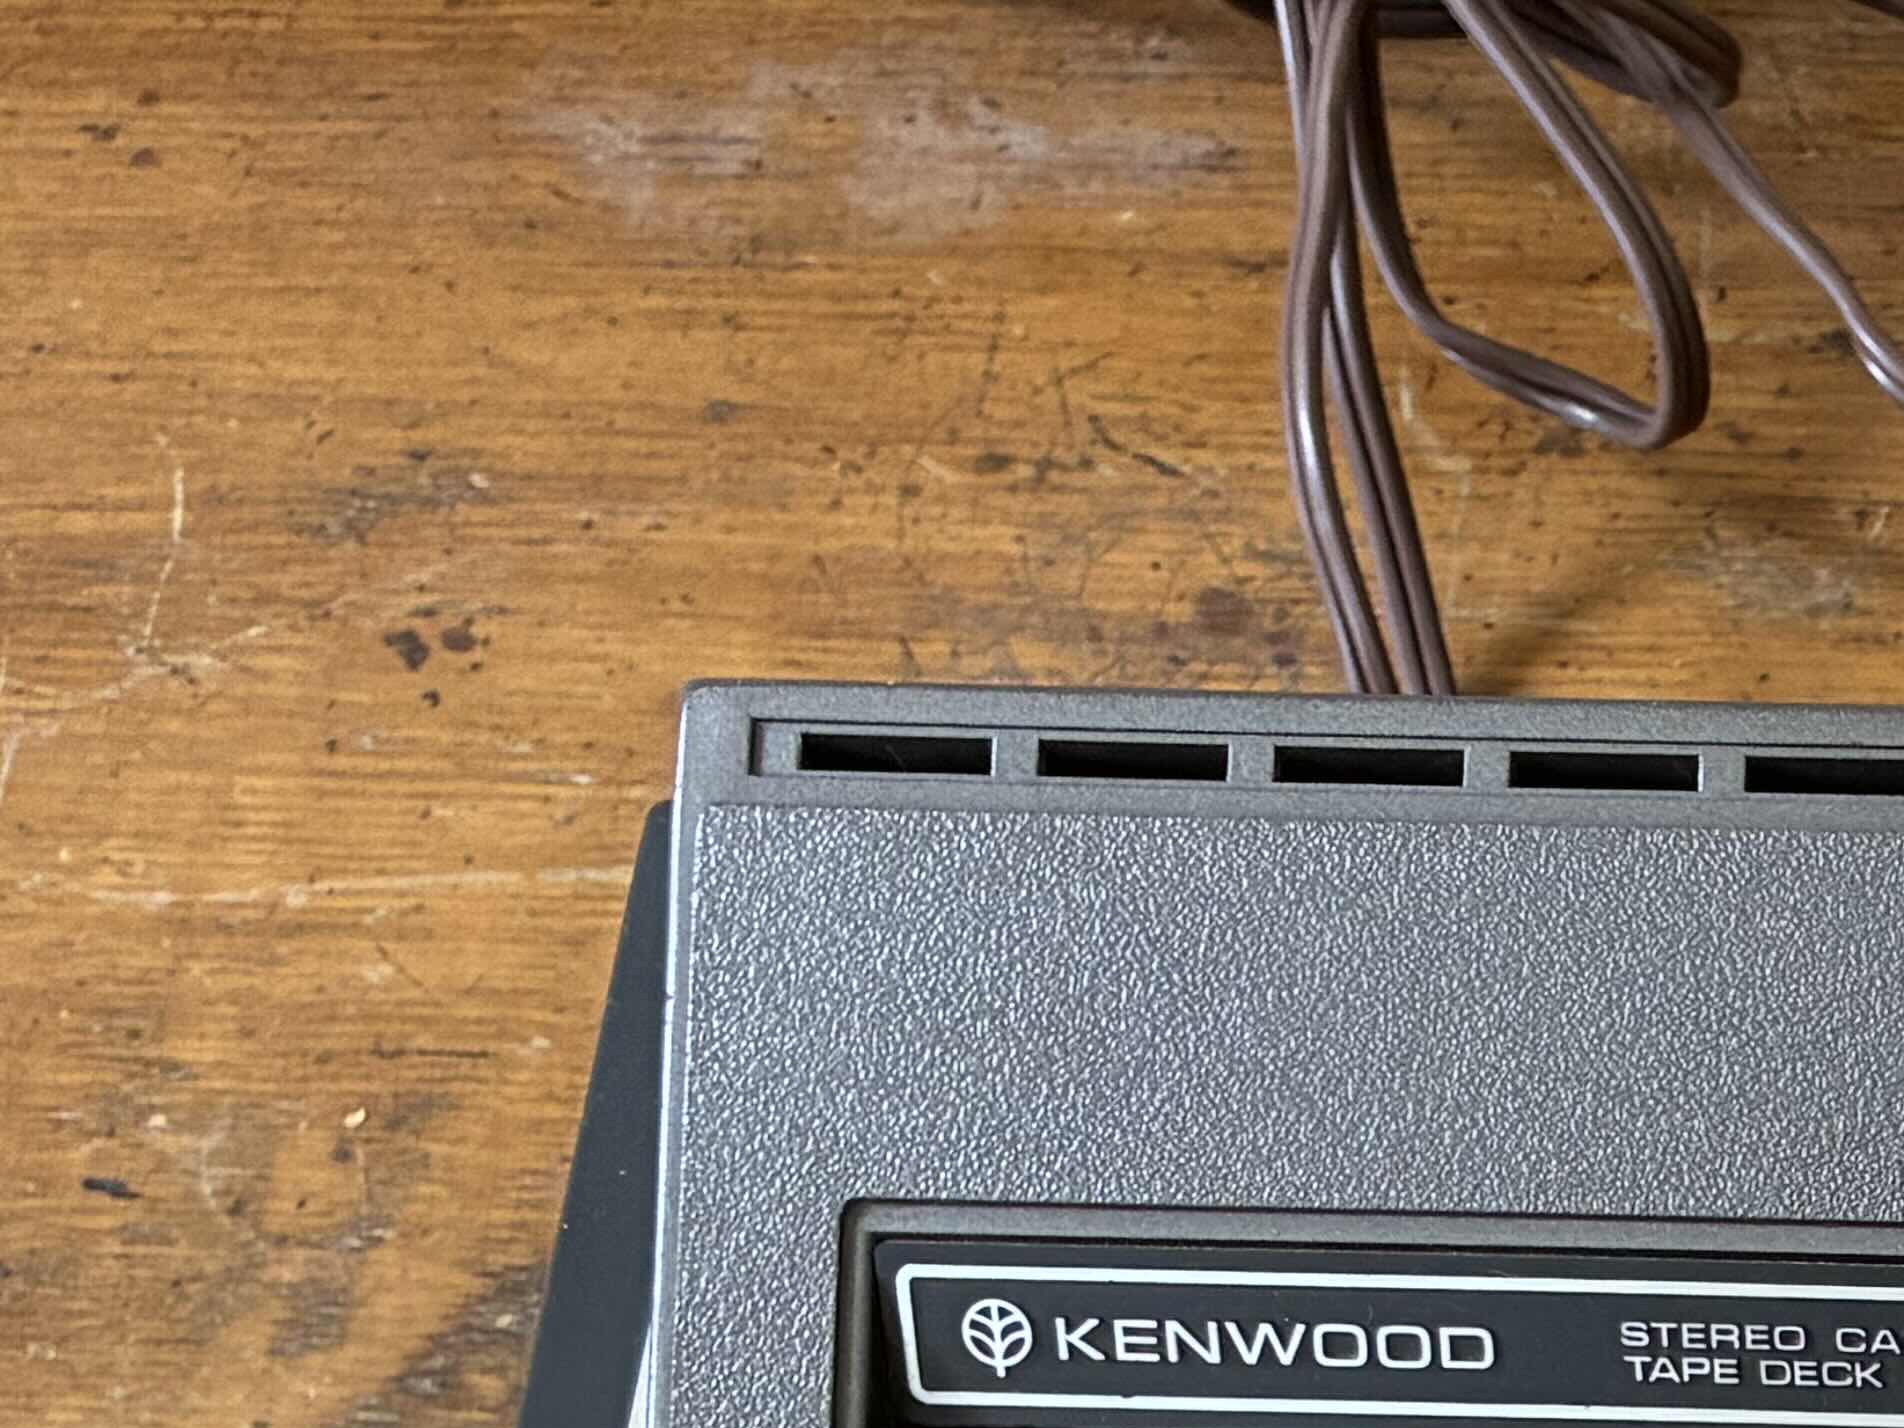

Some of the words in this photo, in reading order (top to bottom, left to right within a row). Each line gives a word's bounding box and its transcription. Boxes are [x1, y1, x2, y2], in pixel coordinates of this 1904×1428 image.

[1054, 1317, 1494, 1370] KENWOOD
[1620, 1321, 1806, 1351] STEREO
[1623, 1355, 1740, 1384] TAPE
[1759, 1359, 1883, 1388] DECK
